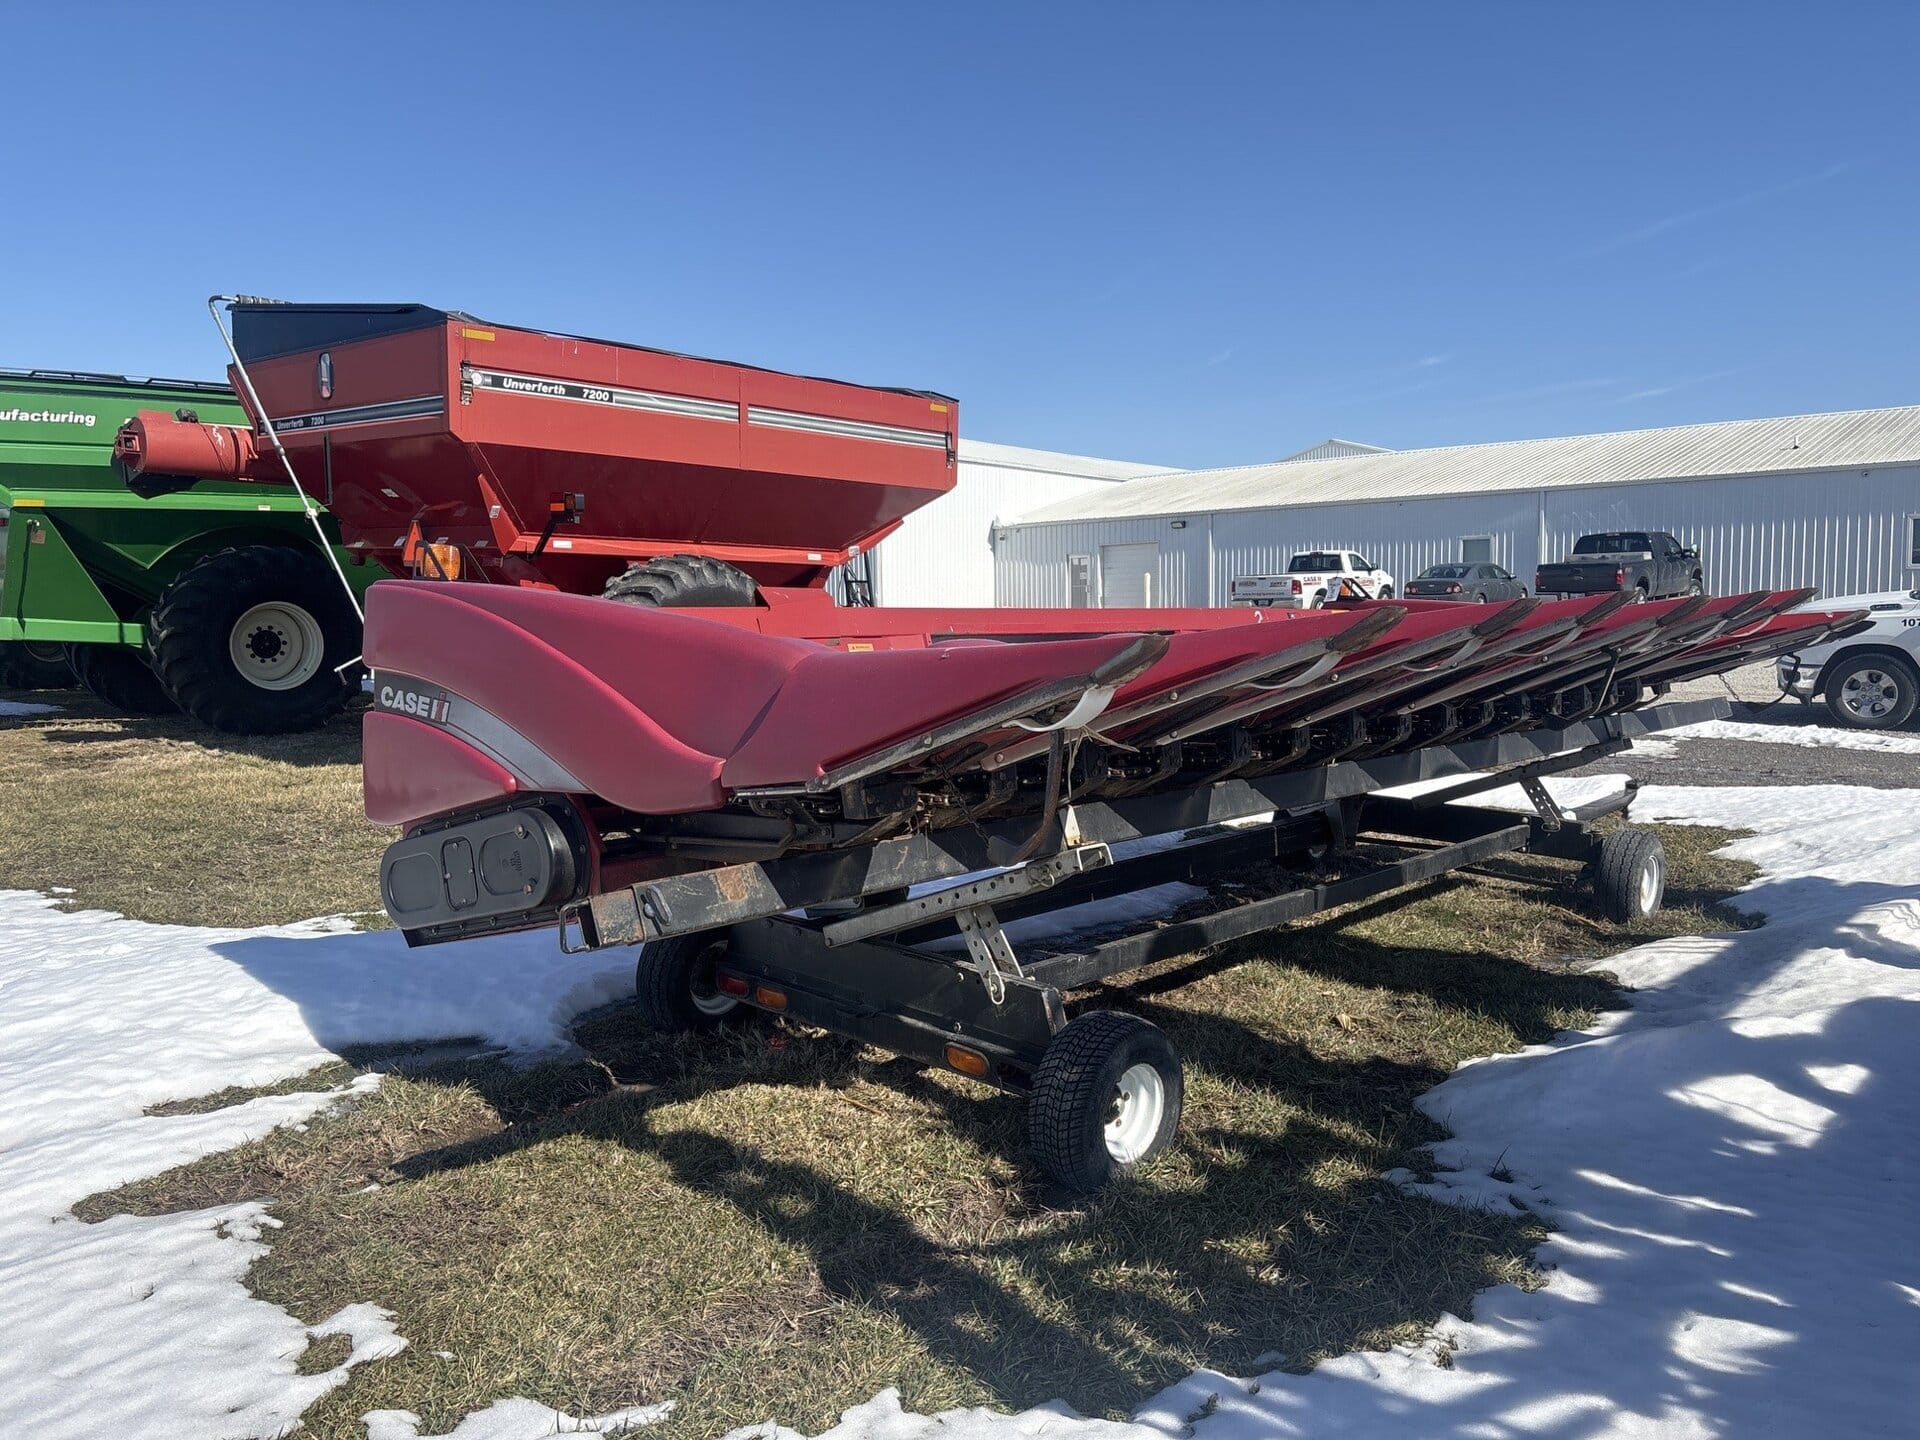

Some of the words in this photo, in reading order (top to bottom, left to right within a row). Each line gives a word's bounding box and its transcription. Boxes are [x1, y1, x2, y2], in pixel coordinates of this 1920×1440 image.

[502, 377, 566, 396] Unverferth
[582, 388, 610, 402] 7200
[0, 409, 96, 427] ufacturing
[380, 685, 431, 718] CASE
